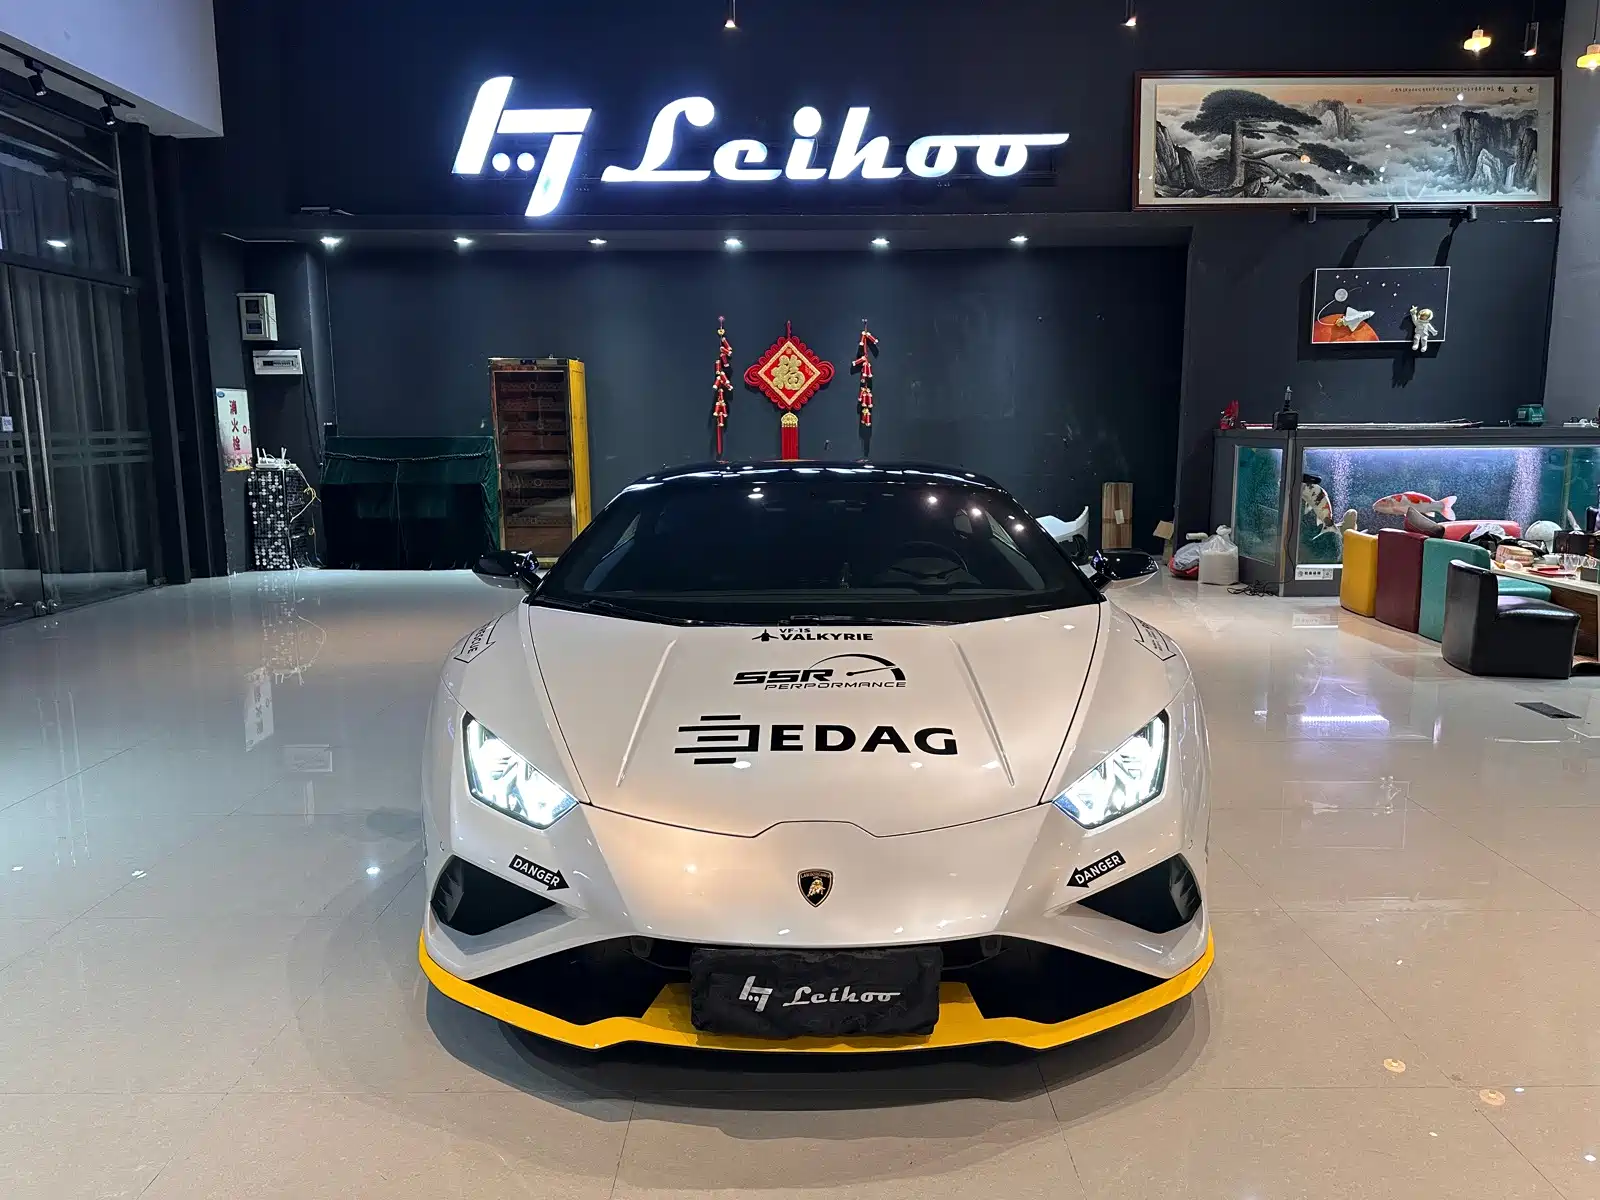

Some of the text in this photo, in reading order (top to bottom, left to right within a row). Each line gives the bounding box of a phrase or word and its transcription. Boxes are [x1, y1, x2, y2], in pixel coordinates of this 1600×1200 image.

[601, 96, 1070, 182] Leihoo
[771, 354, 806, 391] 福
[229, 399, 241, 451] 消火栓
[779, 633, 874, 642] VALKYRIE
[733, 668, 834, 685] SSR
[770, 724, 959, 756] EDAG
[513, 858, 560, 887] DANGER
[1074, 855, 1121, 885] DANGER
[782, 986, 901, 1007] Leihoo
